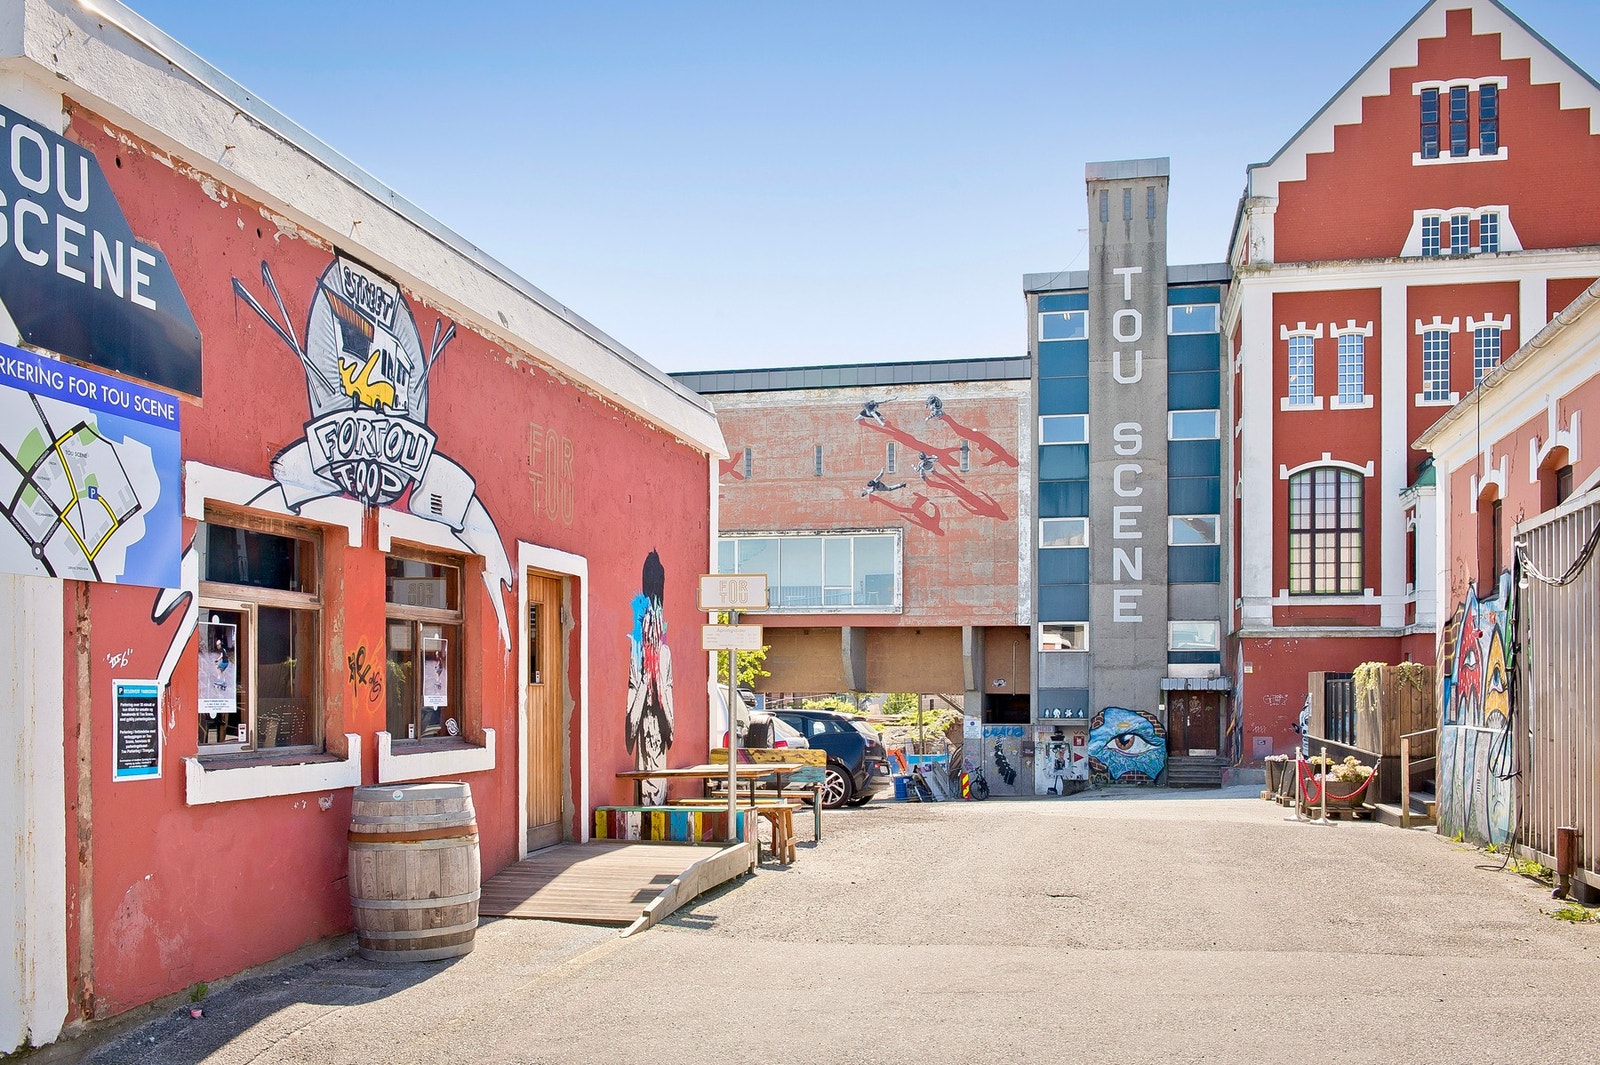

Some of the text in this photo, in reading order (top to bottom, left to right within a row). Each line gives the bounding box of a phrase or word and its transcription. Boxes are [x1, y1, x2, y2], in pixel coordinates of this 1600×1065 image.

[0, 114, 89, 213] OU
[343, 266, 394, 327] STREET
[68, 376, 97, 400] FOR
[101, 385, 129, 408] TOU
[134, 395, 175, 421] SCENE
[529, 422, 574, 482] FOR
[1112, 266, 1142, 622] TOU SCENE
[331, 459, 403, 498] FOOD
[719, 580, 748, 593] FOR
[719, 591, 748, 604] TOU
